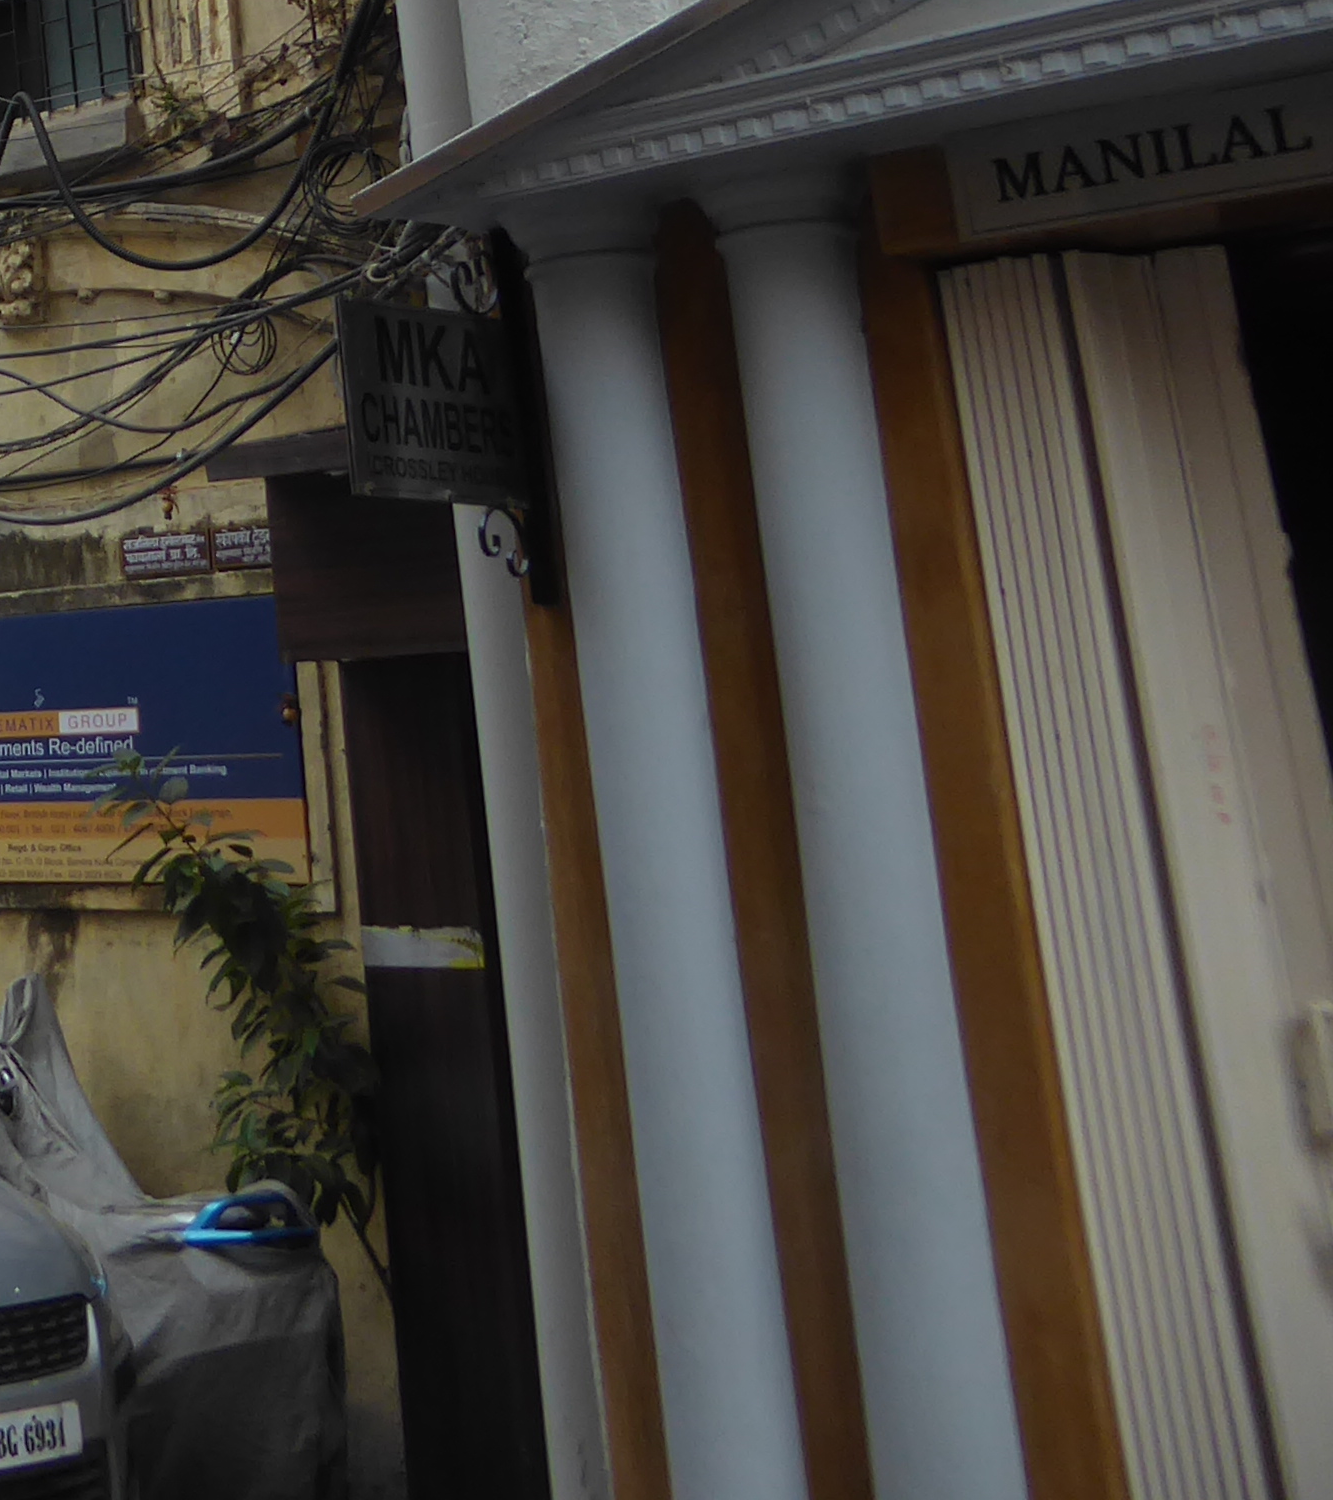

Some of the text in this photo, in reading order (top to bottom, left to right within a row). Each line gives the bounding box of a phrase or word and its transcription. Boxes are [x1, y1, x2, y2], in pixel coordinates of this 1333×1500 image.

[992, 104, 1313, 202] MANILAL
[374, 315, 490, 395] MKA
[361, 392, 515, 457] CHAMBERS
[48, 736, 133, 755] Re-defined
[67, 712, 128, 730] GROUP
[23, 1417, 66, 1454] 6931
